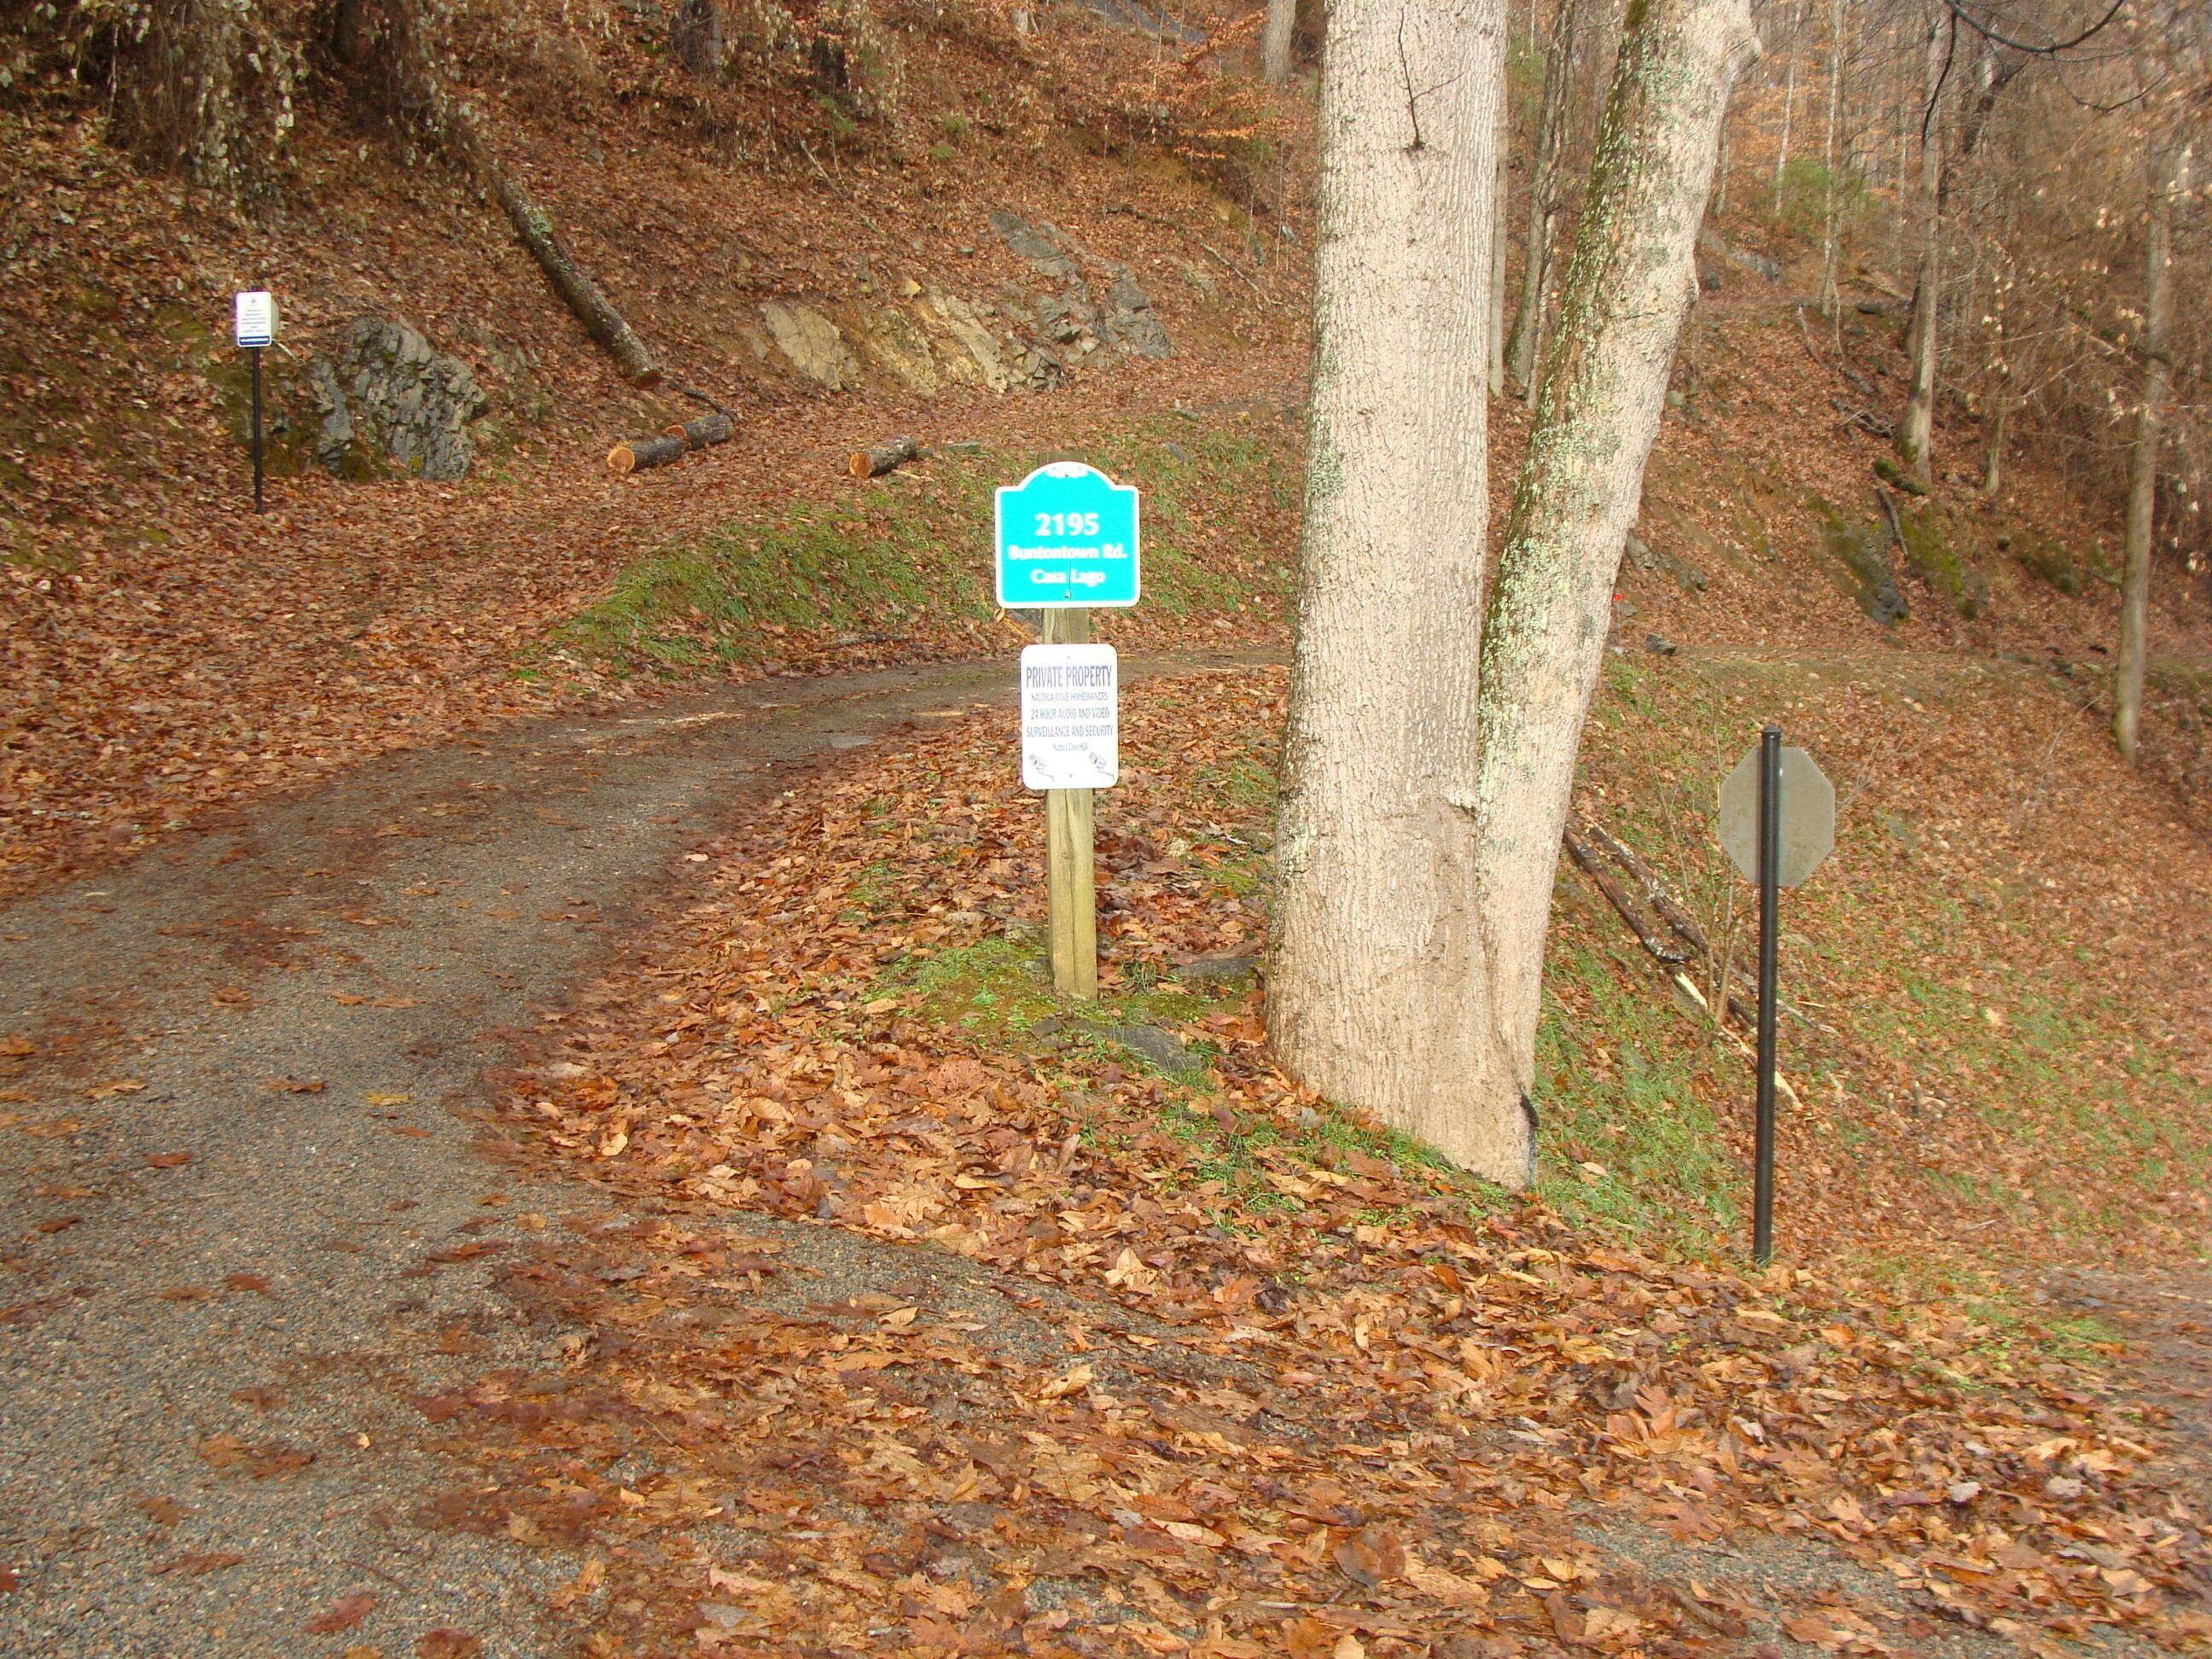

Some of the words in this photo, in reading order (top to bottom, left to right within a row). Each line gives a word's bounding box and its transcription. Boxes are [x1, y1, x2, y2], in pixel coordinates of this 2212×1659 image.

[1034, 512, 1100, 536] 2195
[1070, 568, 1106, 587] Lago
[1026, 666, 1063, 687] PRIVATE
[1066, 665, 1112, 687] PROPERTY
[1031, 693, 1053, 701] NAUTICA
[1055, 692, 1068, 701] COVE
[1070, 692, 1108, 701] HOMEOWNERS
[1031, 708, 1038, 719] 24
[1040, 708, 1057, 719] HOUR
[1058, 708, 1076, 719] AUDIO
[1078, 707, 1090, 719] AND
[1092, 707, 1109, 719] VIDEO
[1027, 726, 1069, 737] SURVEILLANCE
[1072, 725, 1084, 736] AND
[1086, 725, 1114, 736] SECURITY
